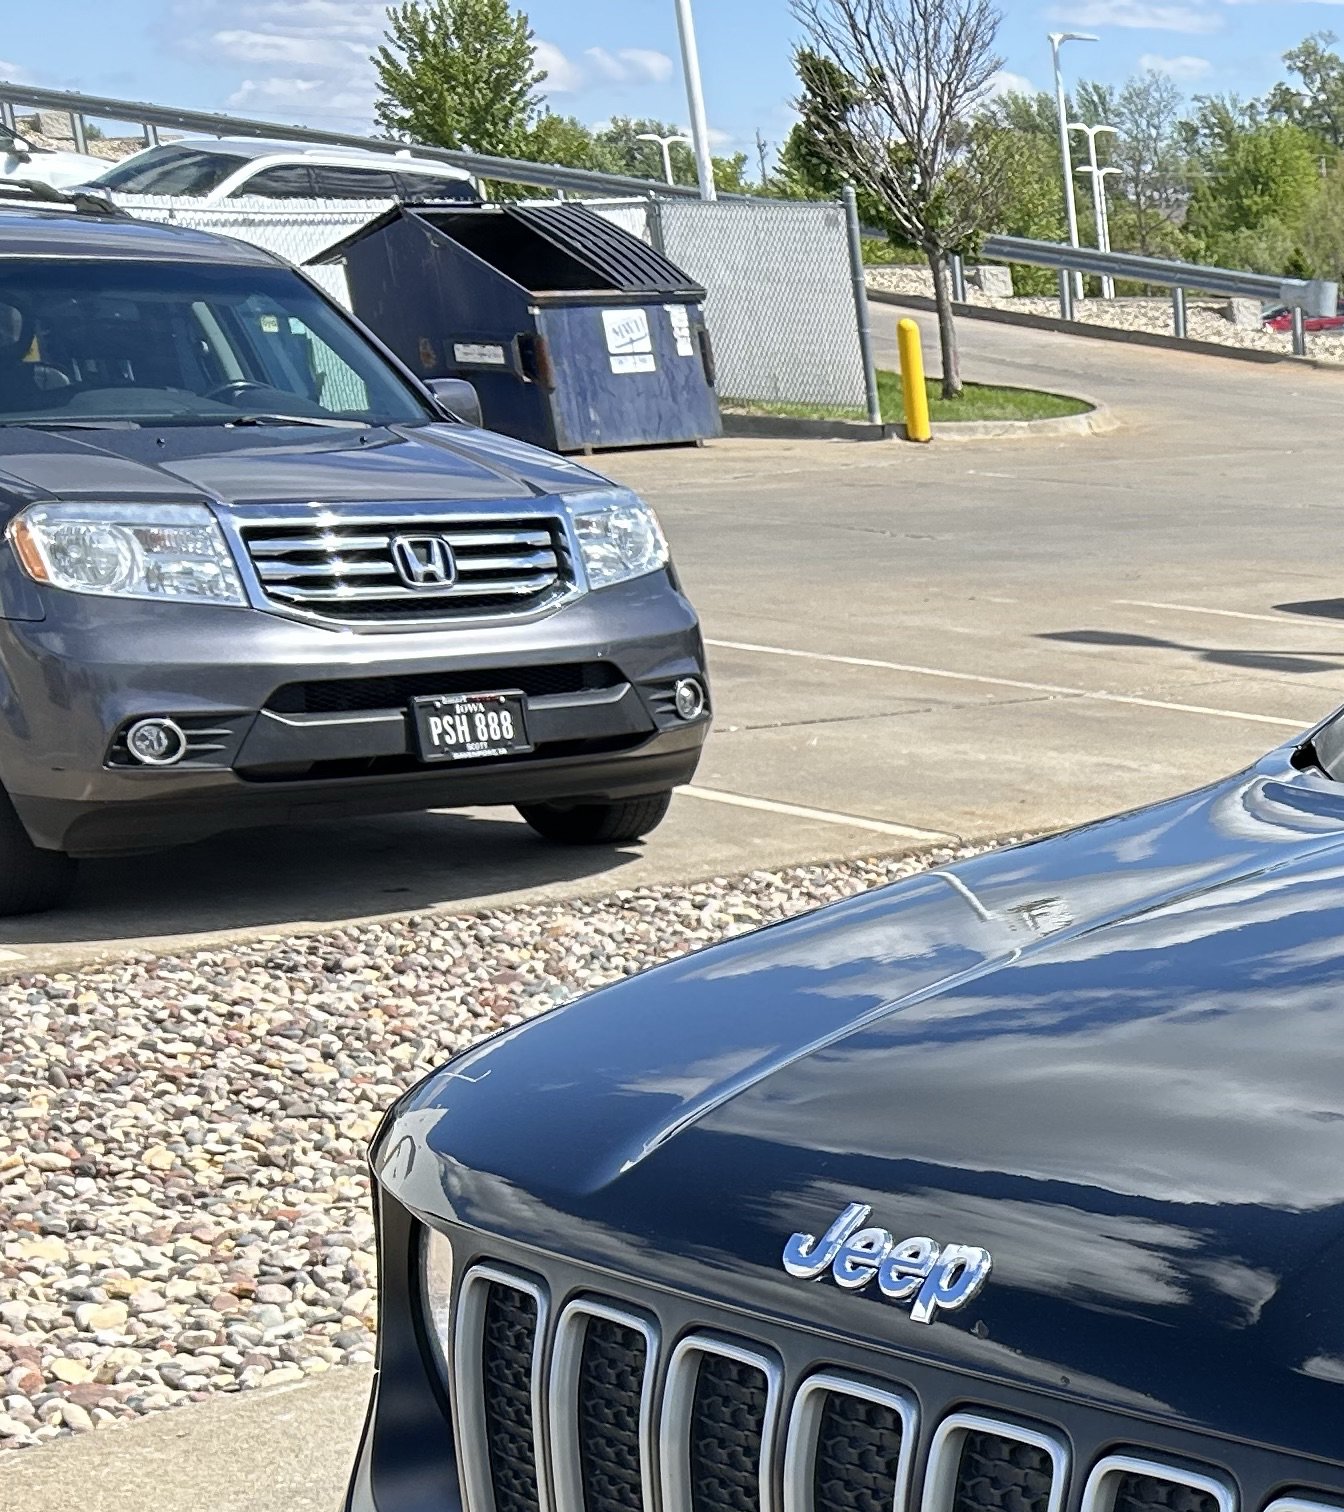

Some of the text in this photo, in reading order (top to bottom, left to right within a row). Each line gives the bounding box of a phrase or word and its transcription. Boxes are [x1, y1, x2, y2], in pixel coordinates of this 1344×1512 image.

[455, 703, 485, 714] IOWA
[429, 710, 514, 746] PSH 888
[465, 741, 488, 751] SCOTT
[783, 1202, 993, 1325] Jeep
